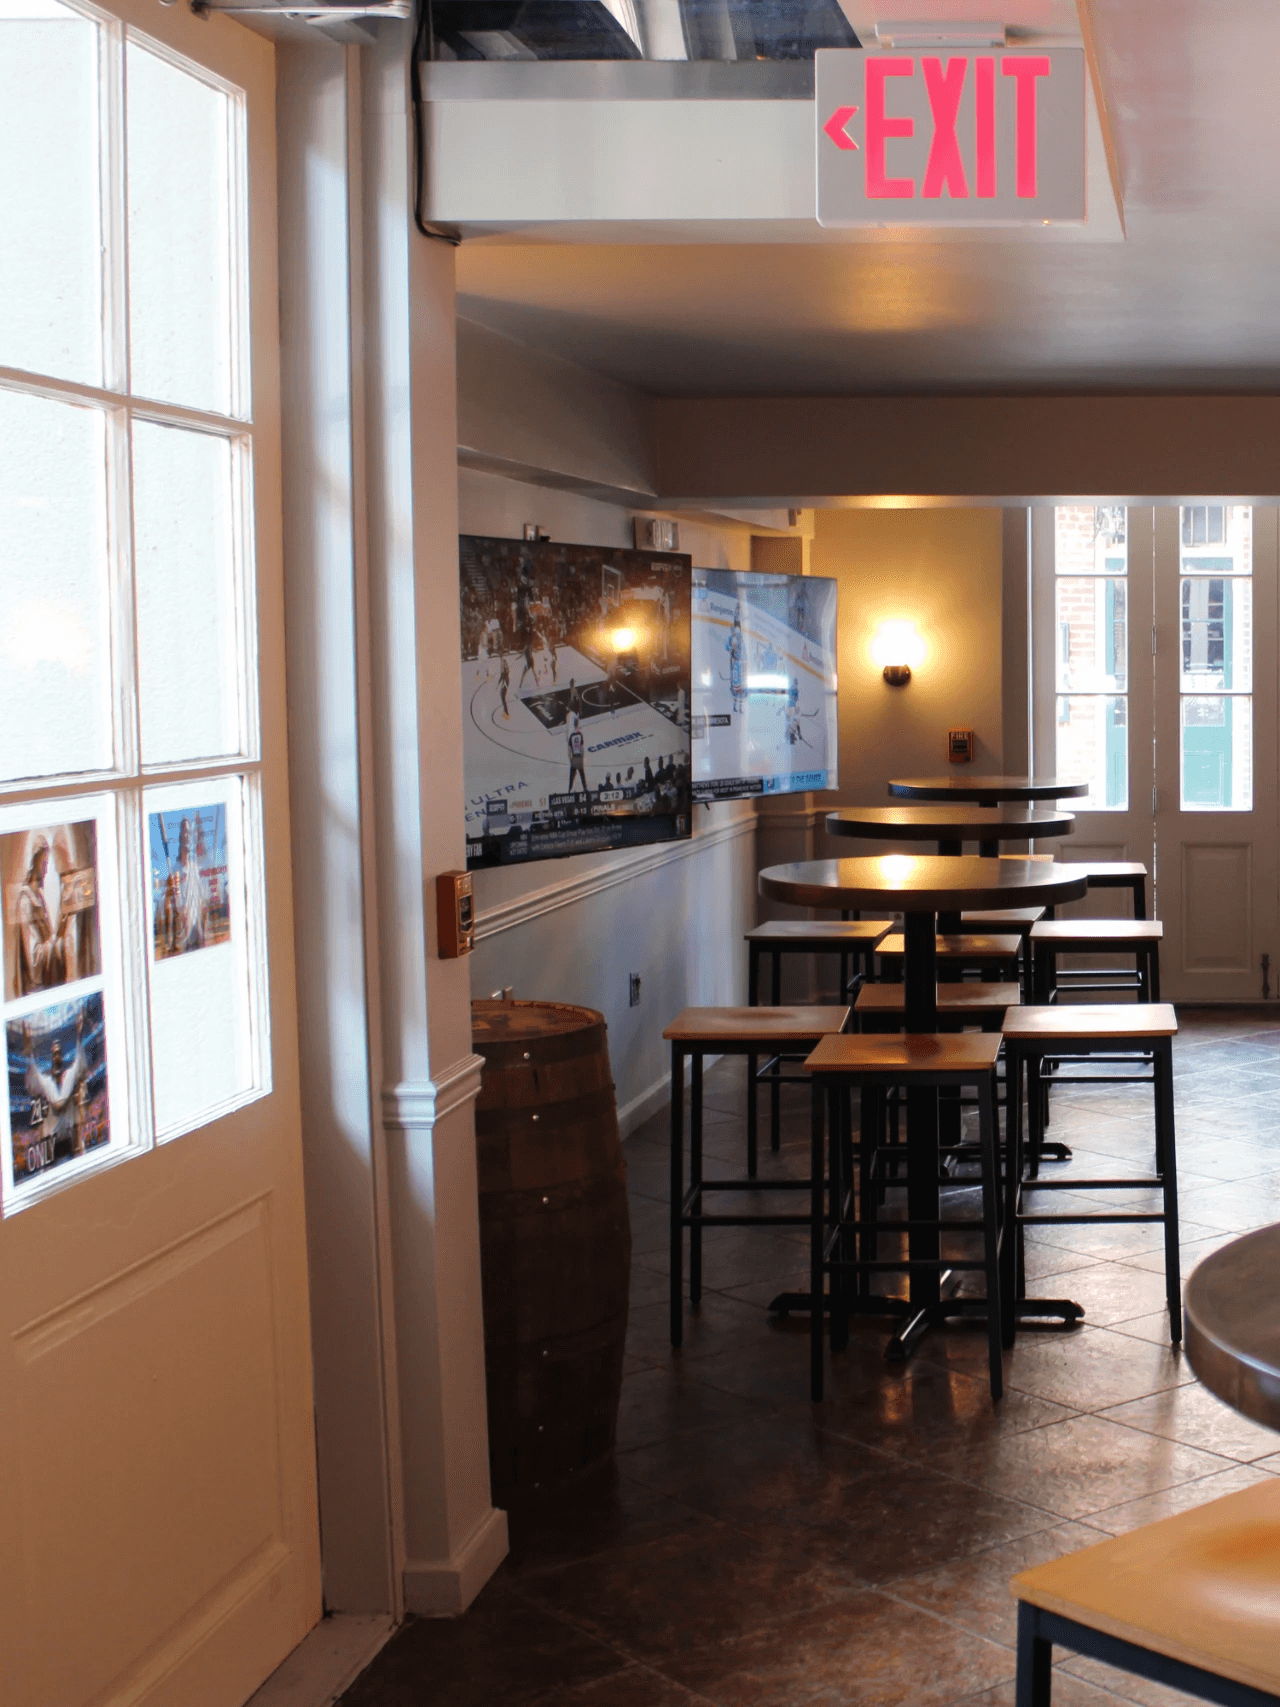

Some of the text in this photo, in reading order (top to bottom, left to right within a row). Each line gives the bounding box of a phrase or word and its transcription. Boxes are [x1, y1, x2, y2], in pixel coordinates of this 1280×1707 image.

[864, 54, 1051, 199] EXIT
[470, 781, 528, 805] ULTRA
[603, 791, 620, 801] 3:12
[28, 1137, 56, 1172] ONLY
